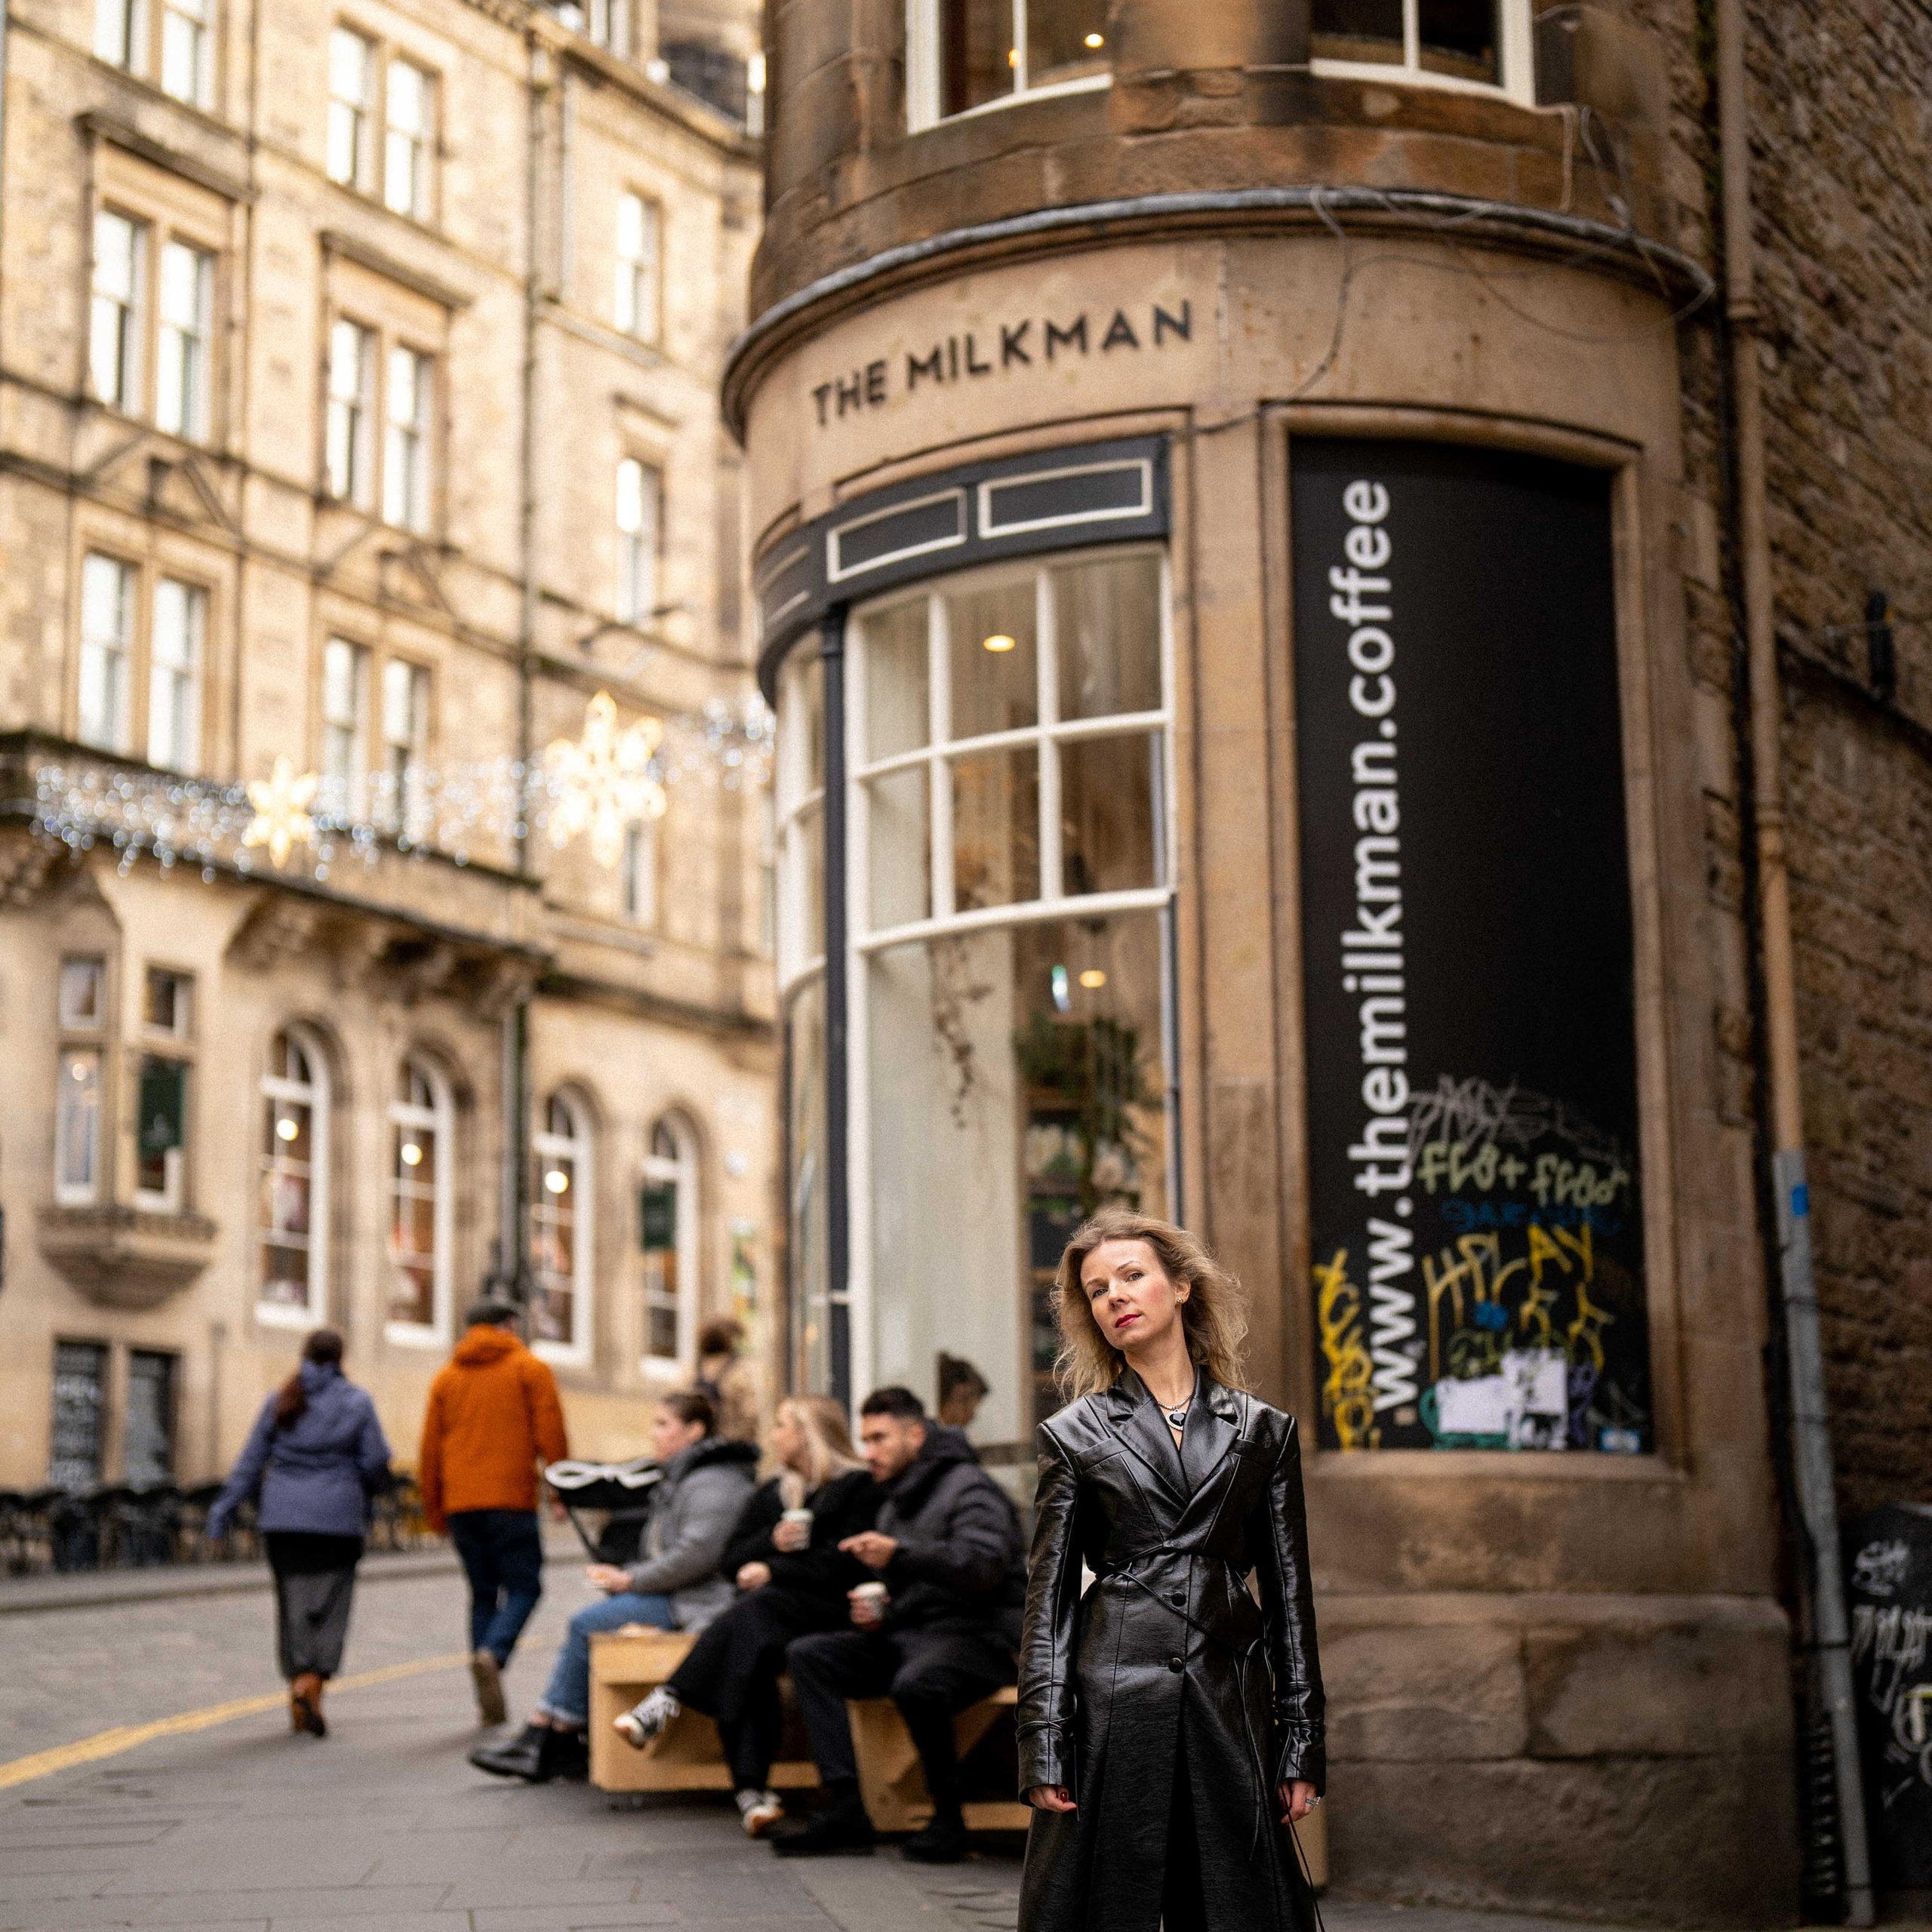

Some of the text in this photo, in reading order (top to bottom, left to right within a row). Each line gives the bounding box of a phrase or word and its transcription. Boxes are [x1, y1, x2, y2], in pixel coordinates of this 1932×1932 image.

[811, 300, 1192, 426] THE MILKMAN
[1328, 479, 1417, 1413] www.themilkman.coffee
